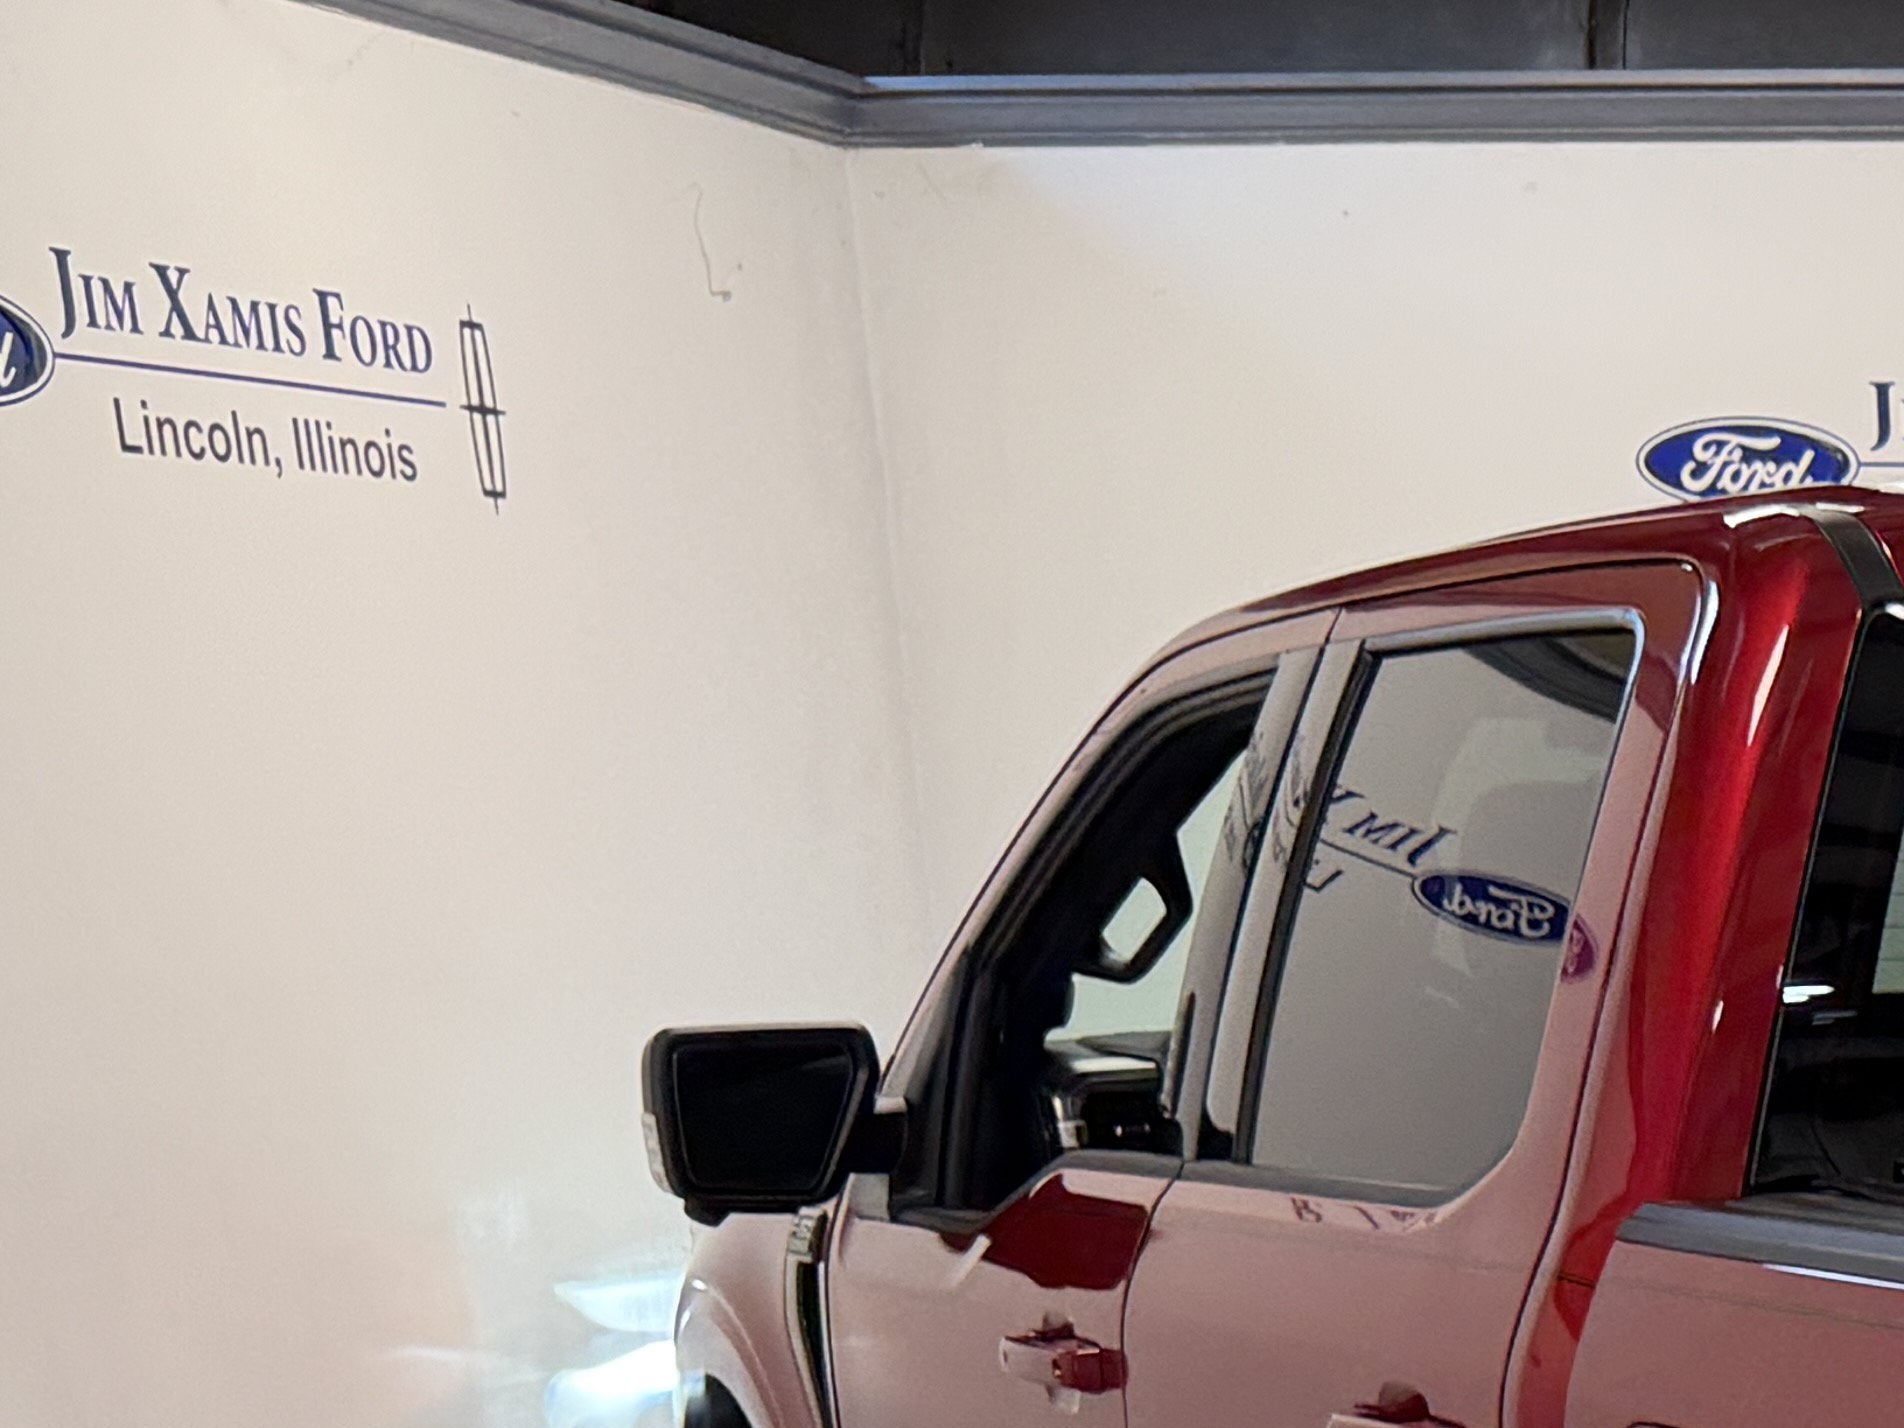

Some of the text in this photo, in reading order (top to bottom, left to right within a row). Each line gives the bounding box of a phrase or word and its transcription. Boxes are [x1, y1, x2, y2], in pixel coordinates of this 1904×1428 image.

[49, 246, 433, 374] JIM XAMIS FORD
[113, 396, 418, 482] Lincoln, Illinois
[1680, 432, 1814, 492] Ford
